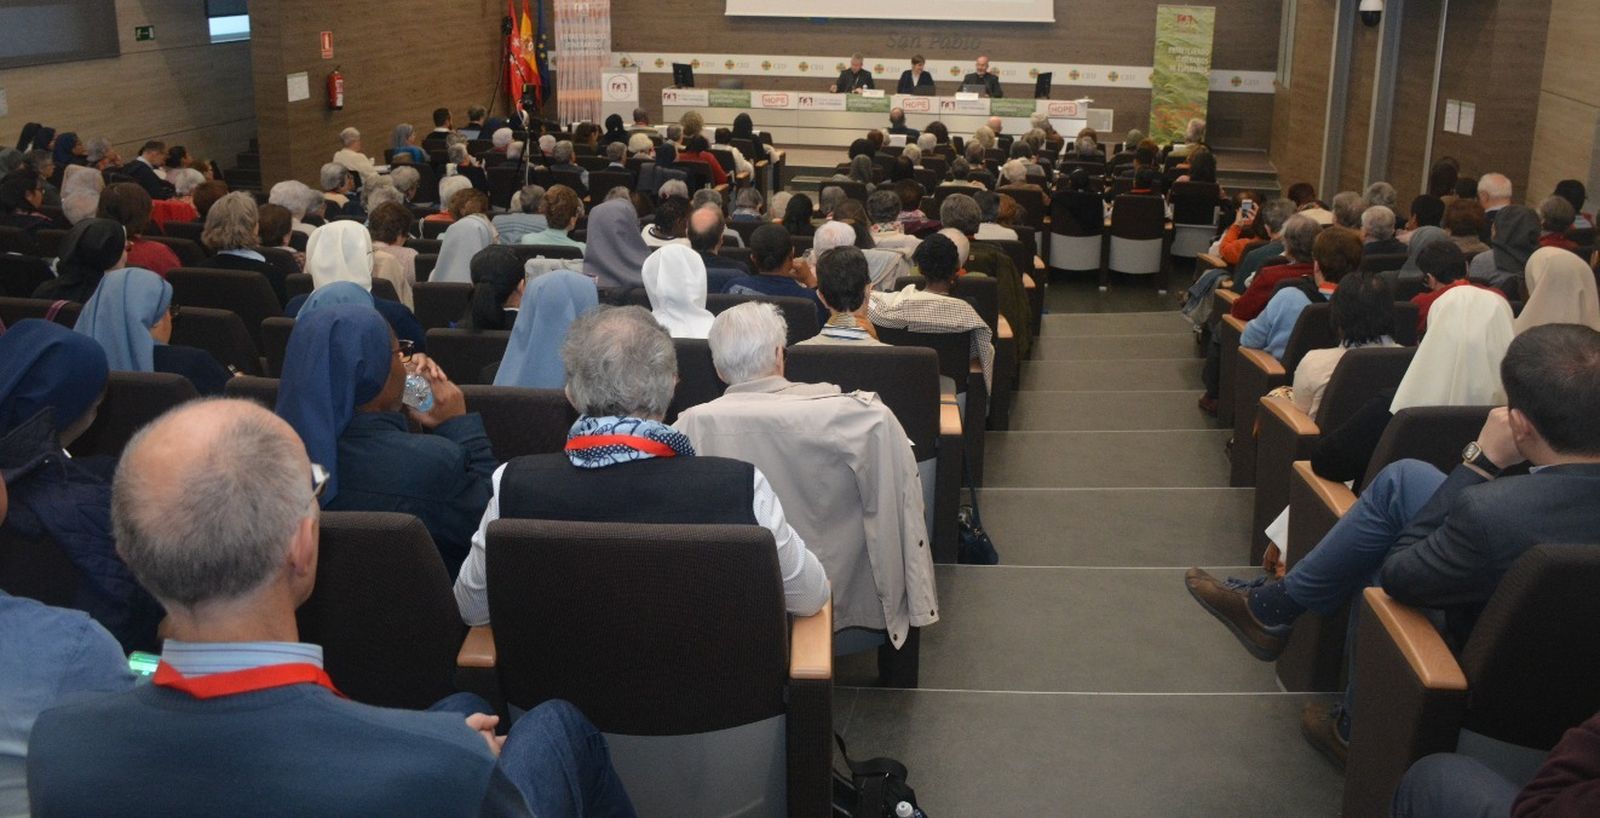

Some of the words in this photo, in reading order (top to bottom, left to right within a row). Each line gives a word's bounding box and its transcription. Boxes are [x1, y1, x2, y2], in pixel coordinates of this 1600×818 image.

[886, 34, 921, 49] San
[928, 32, 981, 50] Pablo
[764, 97, 786, 105] HOPE
[905, 100, 928, 108] HOPE
[1051, 105, 1074, 113] HOPE
